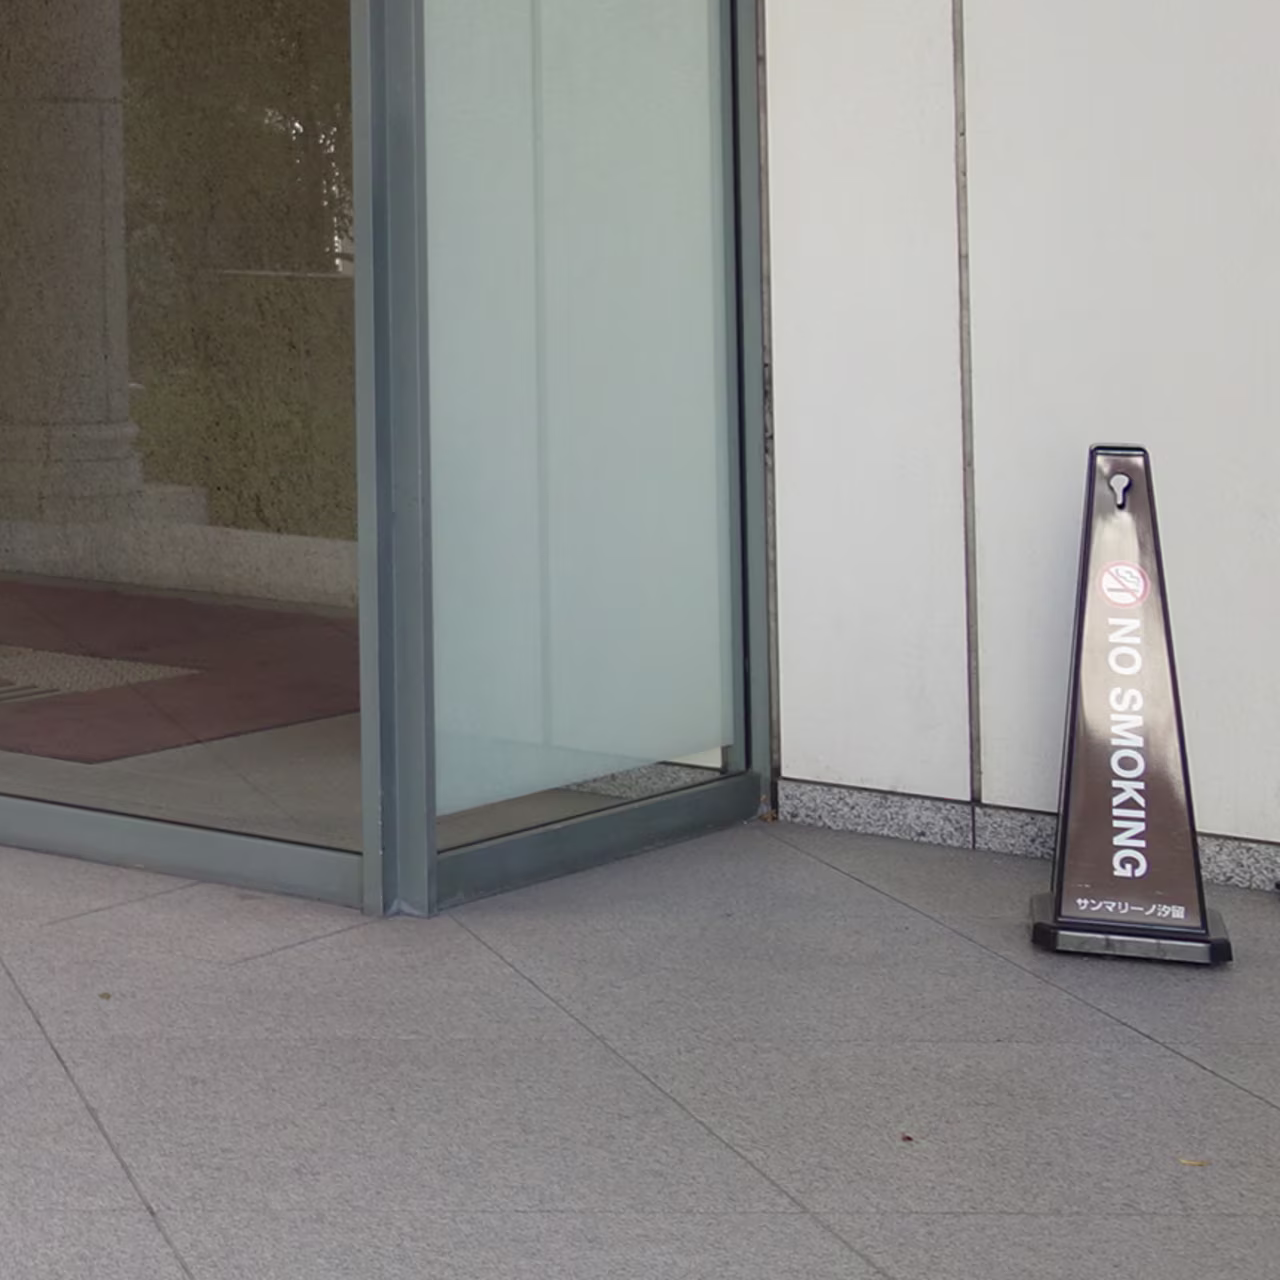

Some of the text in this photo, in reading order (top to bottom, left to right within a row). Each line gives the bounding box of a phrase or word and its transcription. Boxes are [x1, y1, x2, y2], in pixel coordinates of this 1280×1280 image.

[1108, 618, 1147, 879] NO SMOKING
[1076, 898, 1186, 919] サンマリーノ汐留
